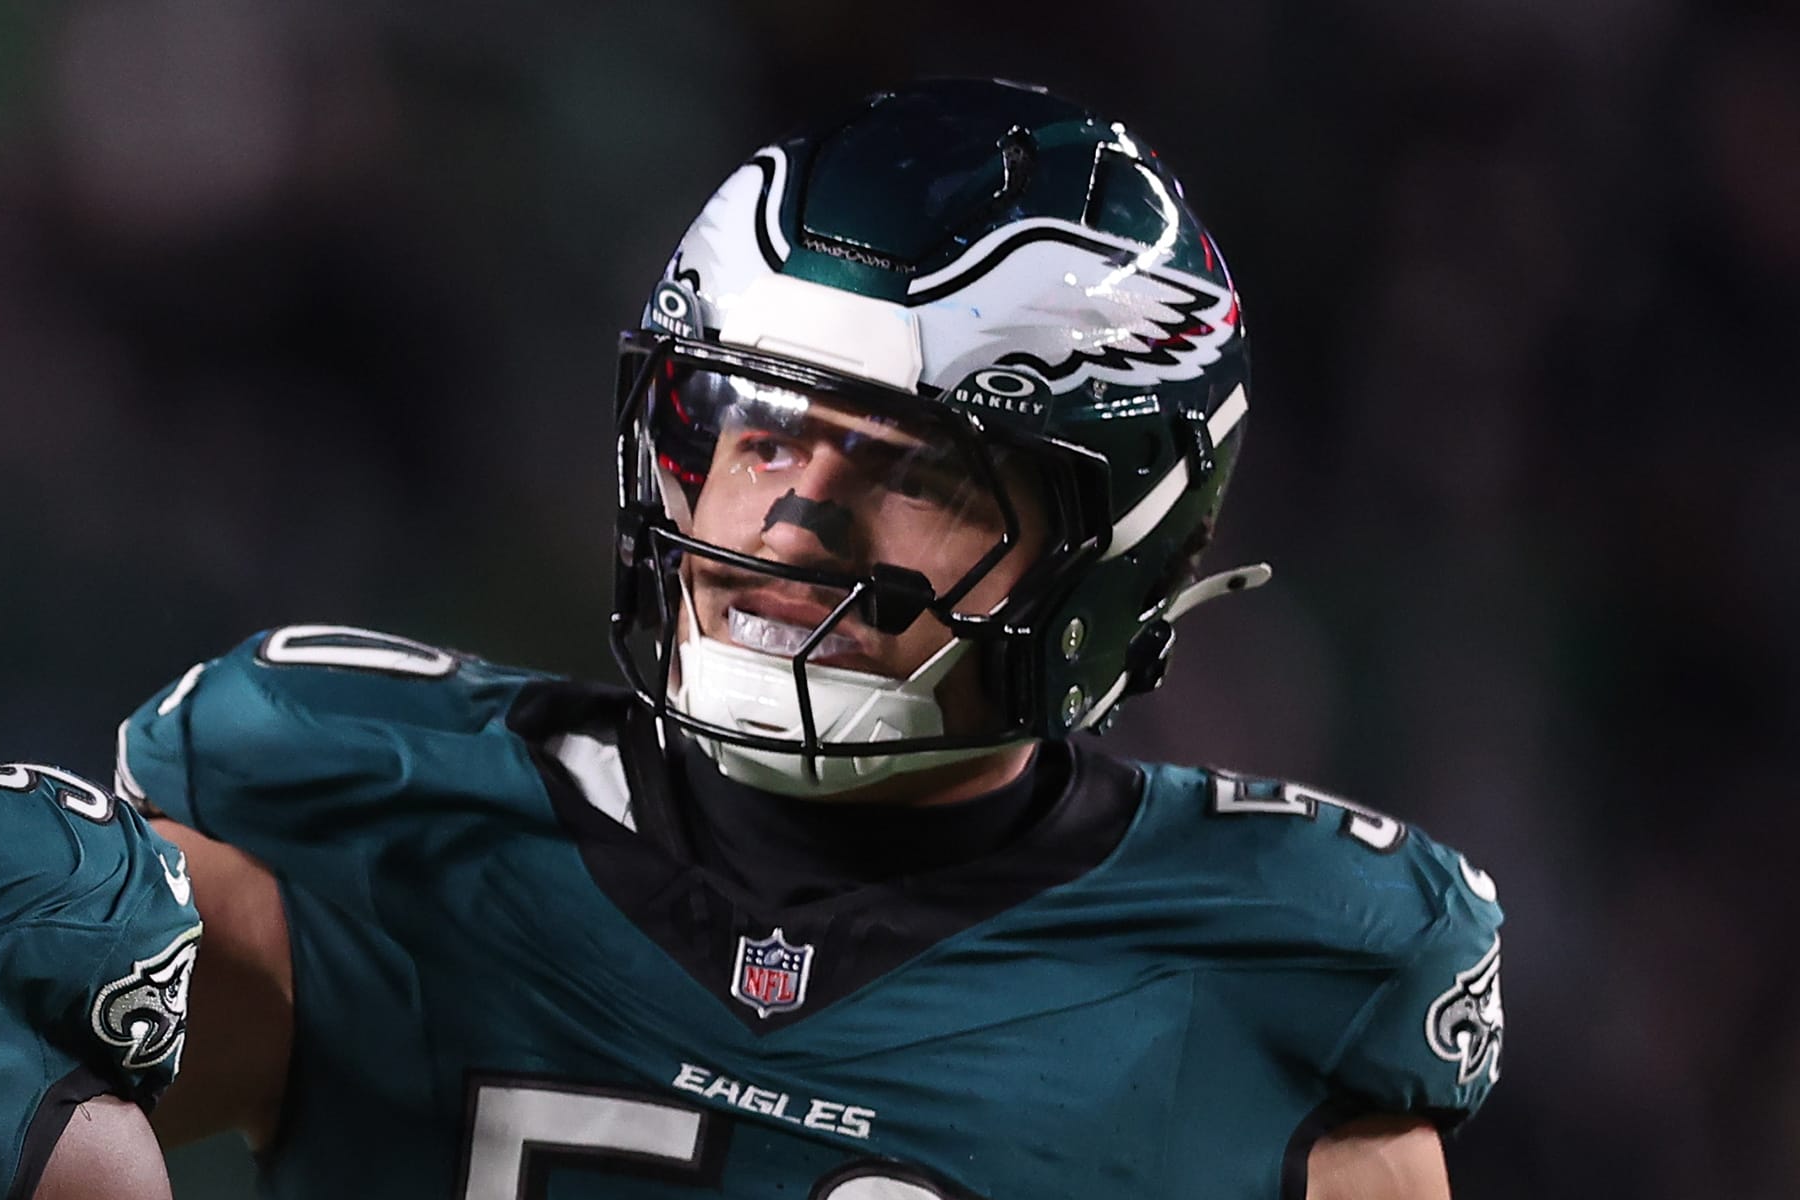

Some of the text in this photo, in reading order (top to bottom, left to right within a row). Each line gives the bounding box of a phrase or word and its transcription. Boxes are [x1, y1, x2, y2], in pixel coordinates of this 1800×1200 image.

[956, 389, 1044, 415] OAKLEY
[744, 965, 795, 1003] NFL
[672, 1062, 876, 1139] EAGLES
